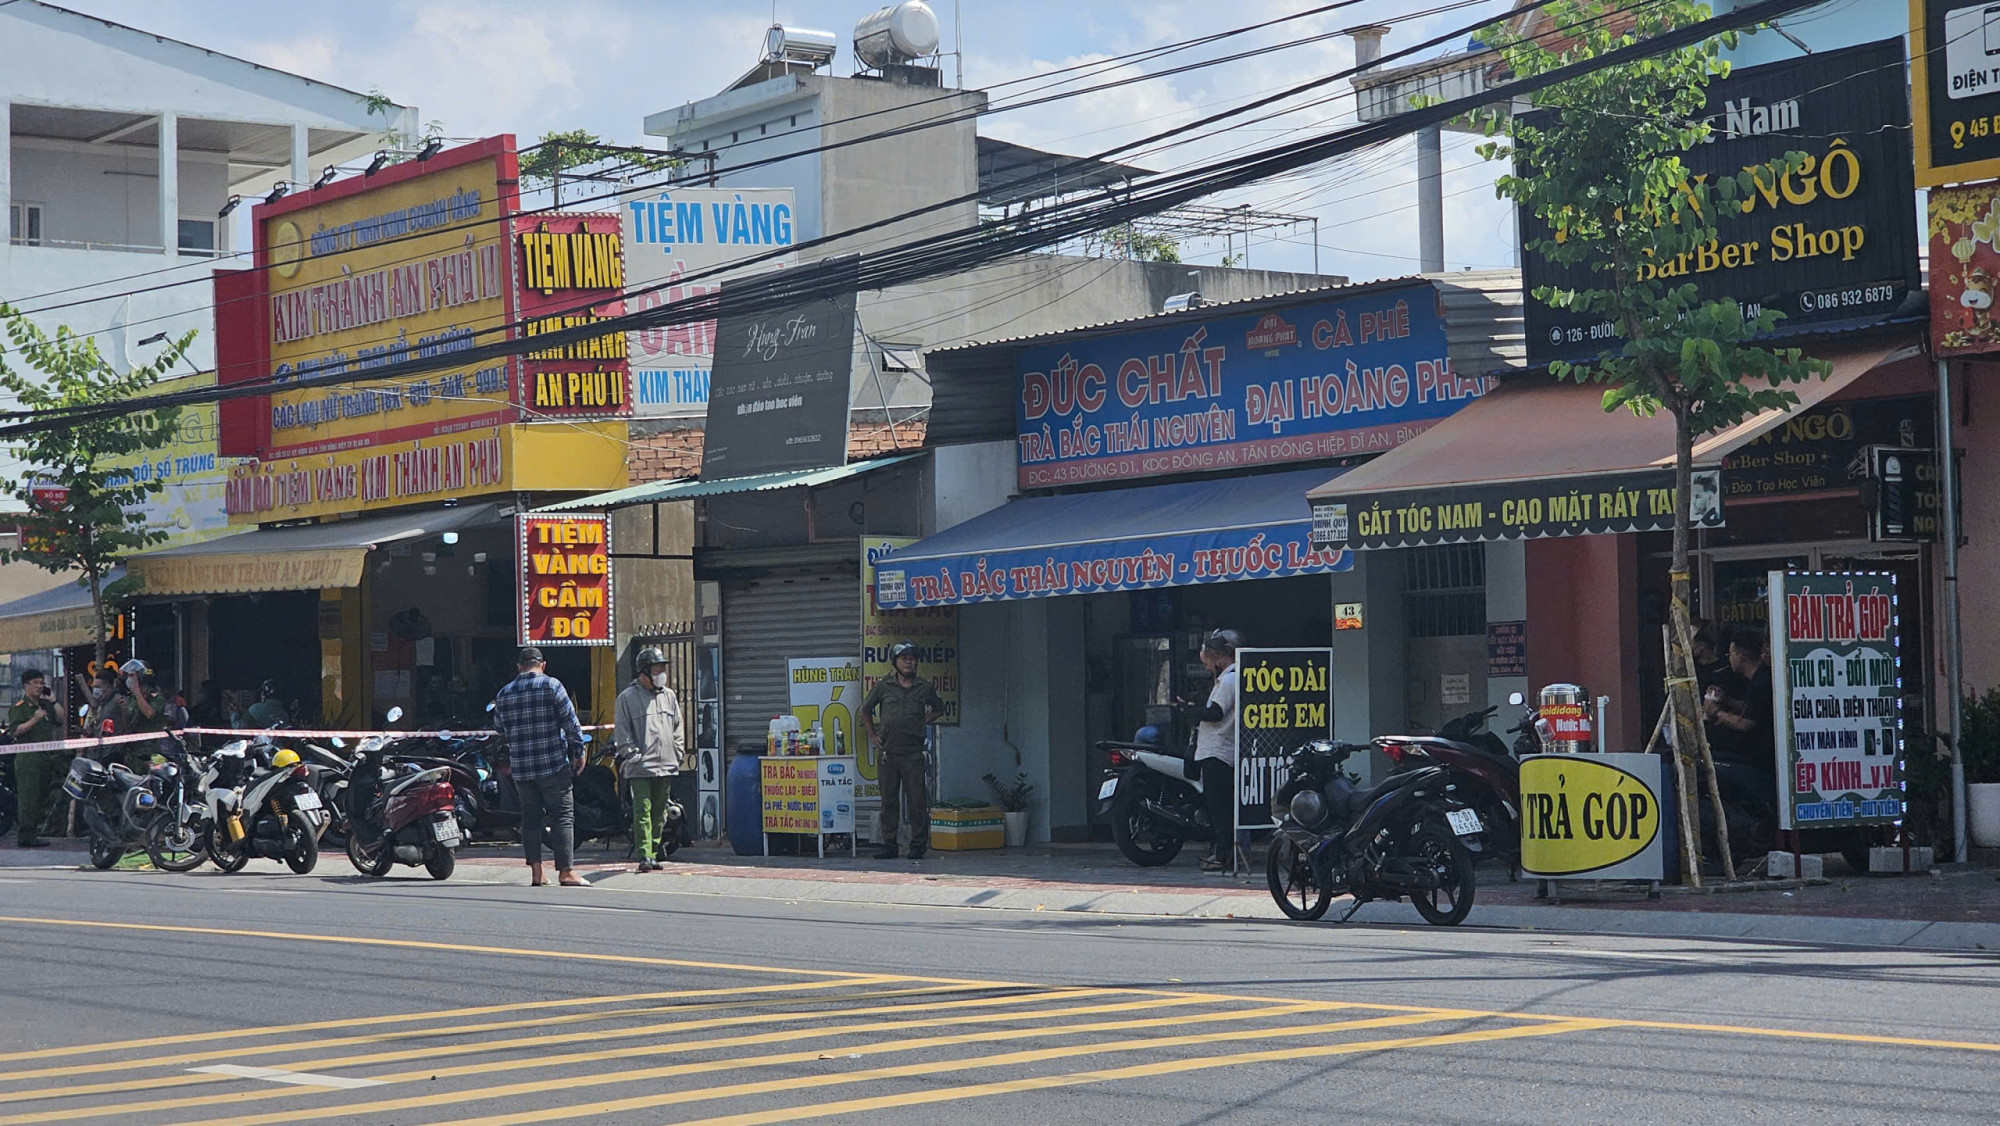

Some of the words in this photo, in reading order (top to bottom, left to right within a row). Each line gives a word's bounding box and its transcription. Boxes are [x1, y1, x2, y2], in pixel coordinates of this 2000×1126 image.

[1952, 68, 1987, 91] ĐIỆN
[1725, 97, 1800, 140] Nam
[1970, 117, 1988, 138] 45
[310, 224, 337, 256] CÔNG
[355, 215, 382, 245] TNHH
[383, 209, 409, 239] KINH
[409, 199, 449, 232] DOANH
[449, 187, 481, 221] VÀNG
[630, 193, 703, 254] TIỆM
[712, 195, 792, 246] VÀNG
[521, 220, 571, 295] TIỆM
[571, 221, 622, 289] VÀNG
[1771, 223, 1865, 261] Shop
[272, 289, 315, 344] KIM
[312, 264, 392, 335] THÀNH
[389, 262, 426, 318] AN
[427, 233, 476, 311] PHÚ
[480, 243, 500, 299] II
[1817, 293, 1839, 309] 086
[1842, 289, 1863, 307] 932
[1866, 285, 1893, 304] 6879
[1312, 307, 1354, 350] CÀ
[1359, 298, 1410, 344] PHÊ
[1747, 302, 1761, 319] AN
[1566, 327, 1583, 343] 126
[536, 372, 561, 407] AN
[569, 365, 607, 406] PHÚ
[610, 371, 624, 405] II
[639, 367, 669, 404] KIM
[1022, 352, 1107, 420] ĐỨC
[1117, 326, 1226, 408] CHẤT
[273, 400, 295, 429] CÁC
[321, 391, 340, 420] NỮ
[340, 392, 377, 418] TRANG
[440, 373, 466, 398] 24K
[475, 364, 509, 394] 999.9
[1245, 379, 1295, 434] ĐẠI
[1301, 358, 1410, 420] HOÀNG
[1020, 422, 1056, 463] TRÀ
[1059, 412, 1101, 457] BẮC
[1104, 411, 1149, 453] THÁI
[1154, 403, 1236, 448] NGUYÊN
[1782, 406, 1853, 443] NGÔ
[133, 456, 152, 483] ĐỔI
[156, 452, 171, 479] SỐ
[175, 452, 215, 475] TRÚNG
[275, 462, 311, 512] TIỆM
[315, 456, 357, 502] VÀNG
[361, 455, 389, 501] KIM
[394, 440, 442, 496] THÀNH
[444, 441, 466, 491] AN
[469, 427, 502, 486] PHÚ
[1029, 470, 1051, 485] ĐC:
[1053, 467, 1067, 481] 43
[1070, 461, 1117, 480] ĐƯỜNG
[1142, 458, 1170, 473] KDC
[1172, 450, 1214, 469] ĐÔNG
[1216, 449, 1238, 464] AN,
[1242, 441, 1268, 459] TÂN
[1271, 437, 1314, 457] ĐÔNG
[1351, 431, 1366, 448] DĨ
[1368, 432, 1393, 447] AN,
[1774, 451, 1817, 467] Shop
[1732, 481, 1752, 494] Đào
[1756, 479, 1775, 494] Tạo
[1779, 477, 1798, 491] Học
[1802, 475, 1826, 489] Viên
[1358, 501, 1390, 536] CẮT
[1397, 501, 1432, 534] TÓC
[1438, 502, 1482, 530] NAM
[1502, 498, 1542, 532] CẠO
[1548, 488, 1592, 530] MẶT
[1599, 487, 1640, 519] RÁY
[535, 519, 603, 549] TIỆM
[213, 561, 235, 583] KIM
[237, 557, 279, 584] THÀNH
[280, 559, 299, 583] AN
[531, 547, 608, 575] VÀNG
[910, 567, 956, 601] TRÀ
[960, 558, 1006, 597] BẮC
[1010, 558, 1067, 592] THÁI
[1071, 547, 1174, 586] NGUYÊN
[1193, 533, 1282, 577] THUỐC
[538, 579, 603, 608] CẦM
[1342, 605, 1356, 617] 43
[1788, 586, 1824, 642] BÁN
[1824, 580, 1857, 642] TRẢ
[1858, 586, 1890, 641] GÓP
[550, 610, 592, 638] ĐỒ
[792, 665, 827, 684] HÙNG
[1243, 660, 1284, 692] TÓC
[1289, 659, 1326, 692] DÀI
[1791, 658, 1814, 687] THU
[1846, 648, 1866, 687] ĐỔI
[1869, 653, 1894, 687] MỚI
[1243, 696, 1289, 729] GHÉ
[1294, 703, 1326, 728] EM
[1794, 694, 1814, 719] SỬA
[1815, 695, 1841, 719] CHỮA
[1843, 695, 1865, 722] ĐIỆN
[1866, 696, 1894, 722] THOẠI
[1795, 731, 1815, 750] THAY
[1817, 728, 1837, 749] MÀN
[1838, 728, 1858, 749] HÌNH
[764, 781, 784, 796] THUỐC
[820, 778, 836, 787] TRÀ
[1240, 738, 1266, 806] CẮT
[1795, 758, 1816, 793] ÉP
[1527, 773, 1573, 840] TRẢ
[1583, 776, 1648, 841] GÓP
